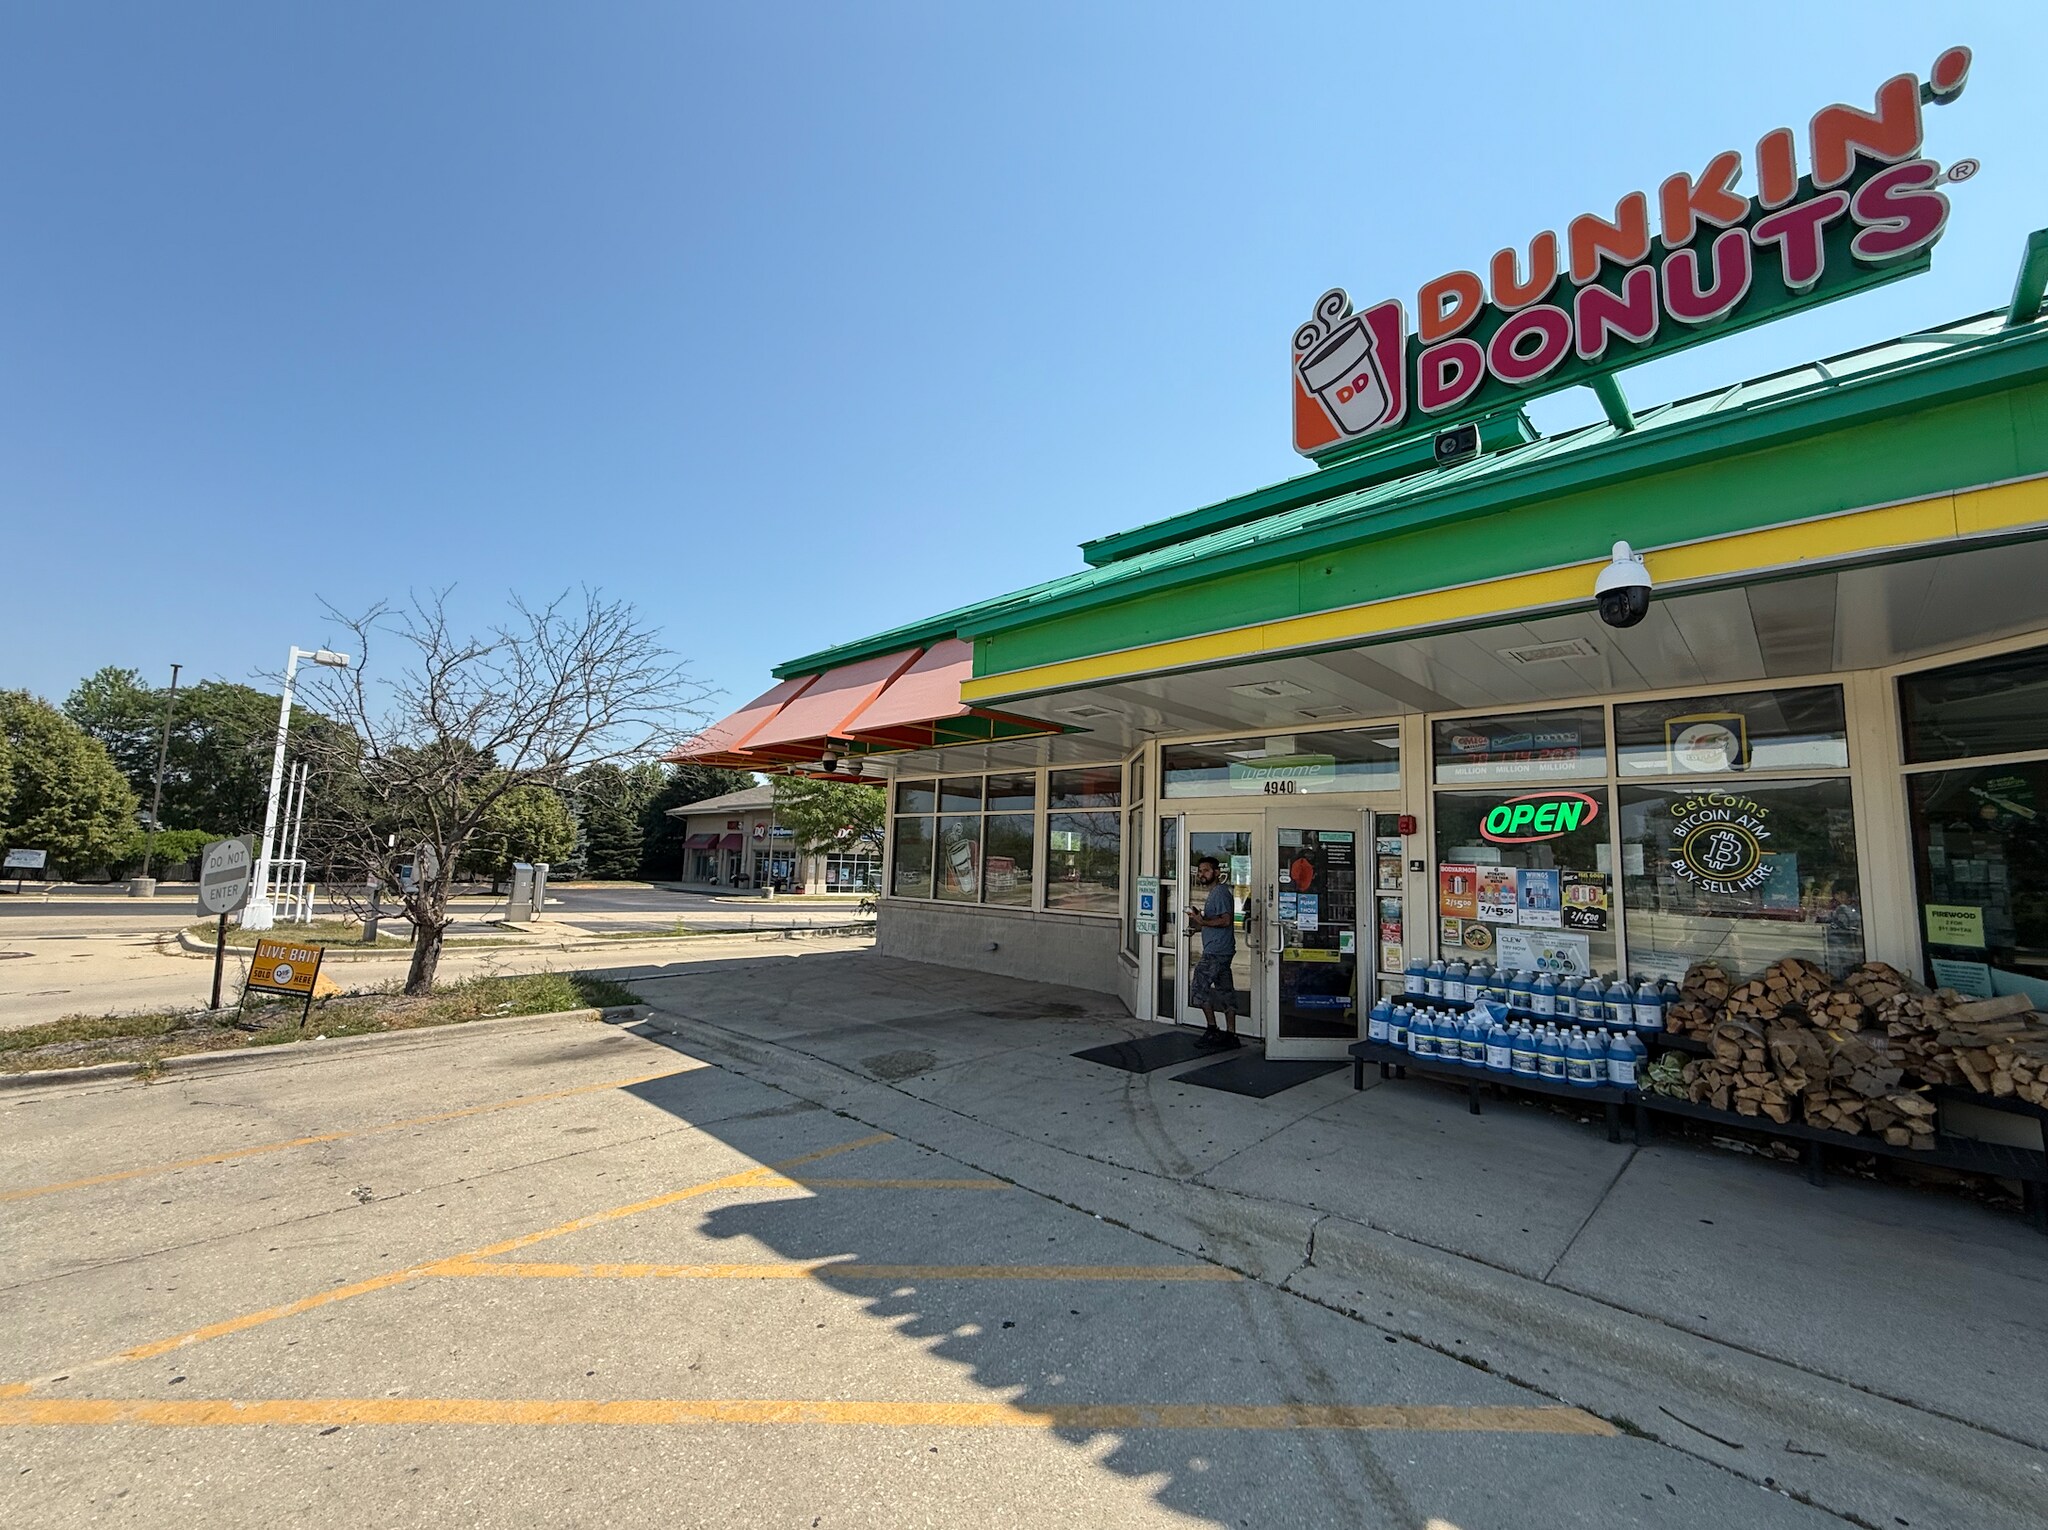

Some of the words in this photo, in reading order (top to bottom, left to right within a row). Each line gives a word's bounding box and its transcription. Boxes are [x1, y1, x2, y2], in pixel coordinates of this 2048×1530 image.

[1417, 45, 1972, 346] DUNKIN'
[1416, 159, 1951, 415] DONUTS
[1336, 372, 1370, 405] DD
[1241, 764, 1322, 780] welcome
[1455, 767, 1487, 775] MILLION
[1496, 765, 1530, 773] MILLION
[1539, 762, 1576, 771] MILLION
[1264, 780, 1294, 794] 4940
[1670, 792, 1770, 819] GetCoins
[1486, 801, 1583, 834] OPEN
[1673, 809, 1731, 838] BITCOIN
[1735, 814, 1771, 840] ATM
[210, 857, 223, 868] DO
[227, 851, 245, 864] NOT
[1736, 863, 1774, 892] HERE
[210, 884, 238, 900] ENTER
[1932, 911, 1976, 919] FIREWOOD
[259, 944, 287, 960] LIVE
[289, 948, 319, 964] BAIT
[254, 969, 271, 979] SOLD
[293, 975, 312, 985] HERE
